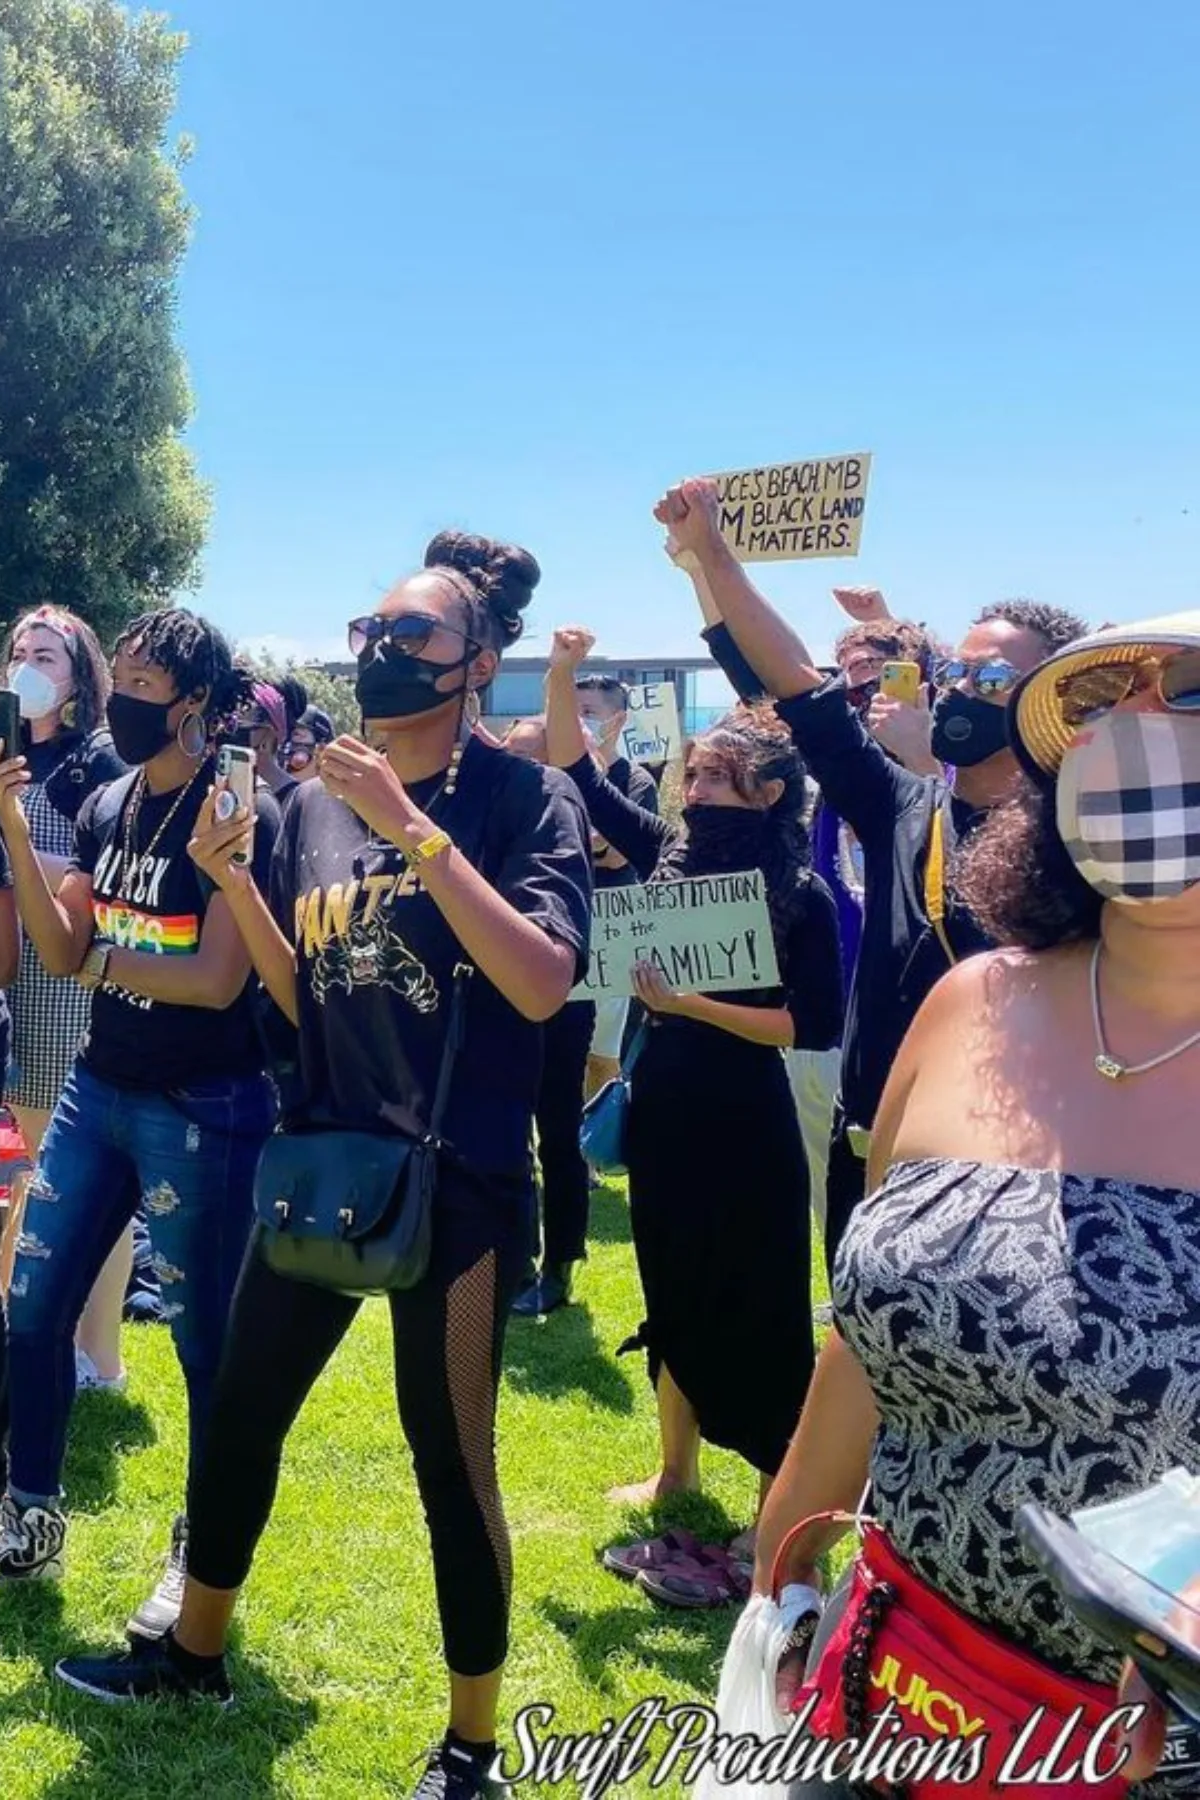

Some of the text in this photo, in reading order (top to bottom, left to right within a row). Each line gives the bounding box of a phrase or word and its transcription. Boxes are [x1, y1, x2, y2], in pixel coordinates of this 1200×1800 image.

[824, 459, 861, 490] MB
[751, 497, 814, 527] BLACK
[820, 497, 865, 520] LAND
[748, 522, 851, 552] MATTERS.
[93, 843, 171, 907] BLACK
[294, 865, 428, 959] PANTE
[593, 889, 634, 918] TION
[644, 874, 759, 912] RESTITUTION
[603, 919, 655, 941] to the
[870, 1654, 985, 1736] JUICY
